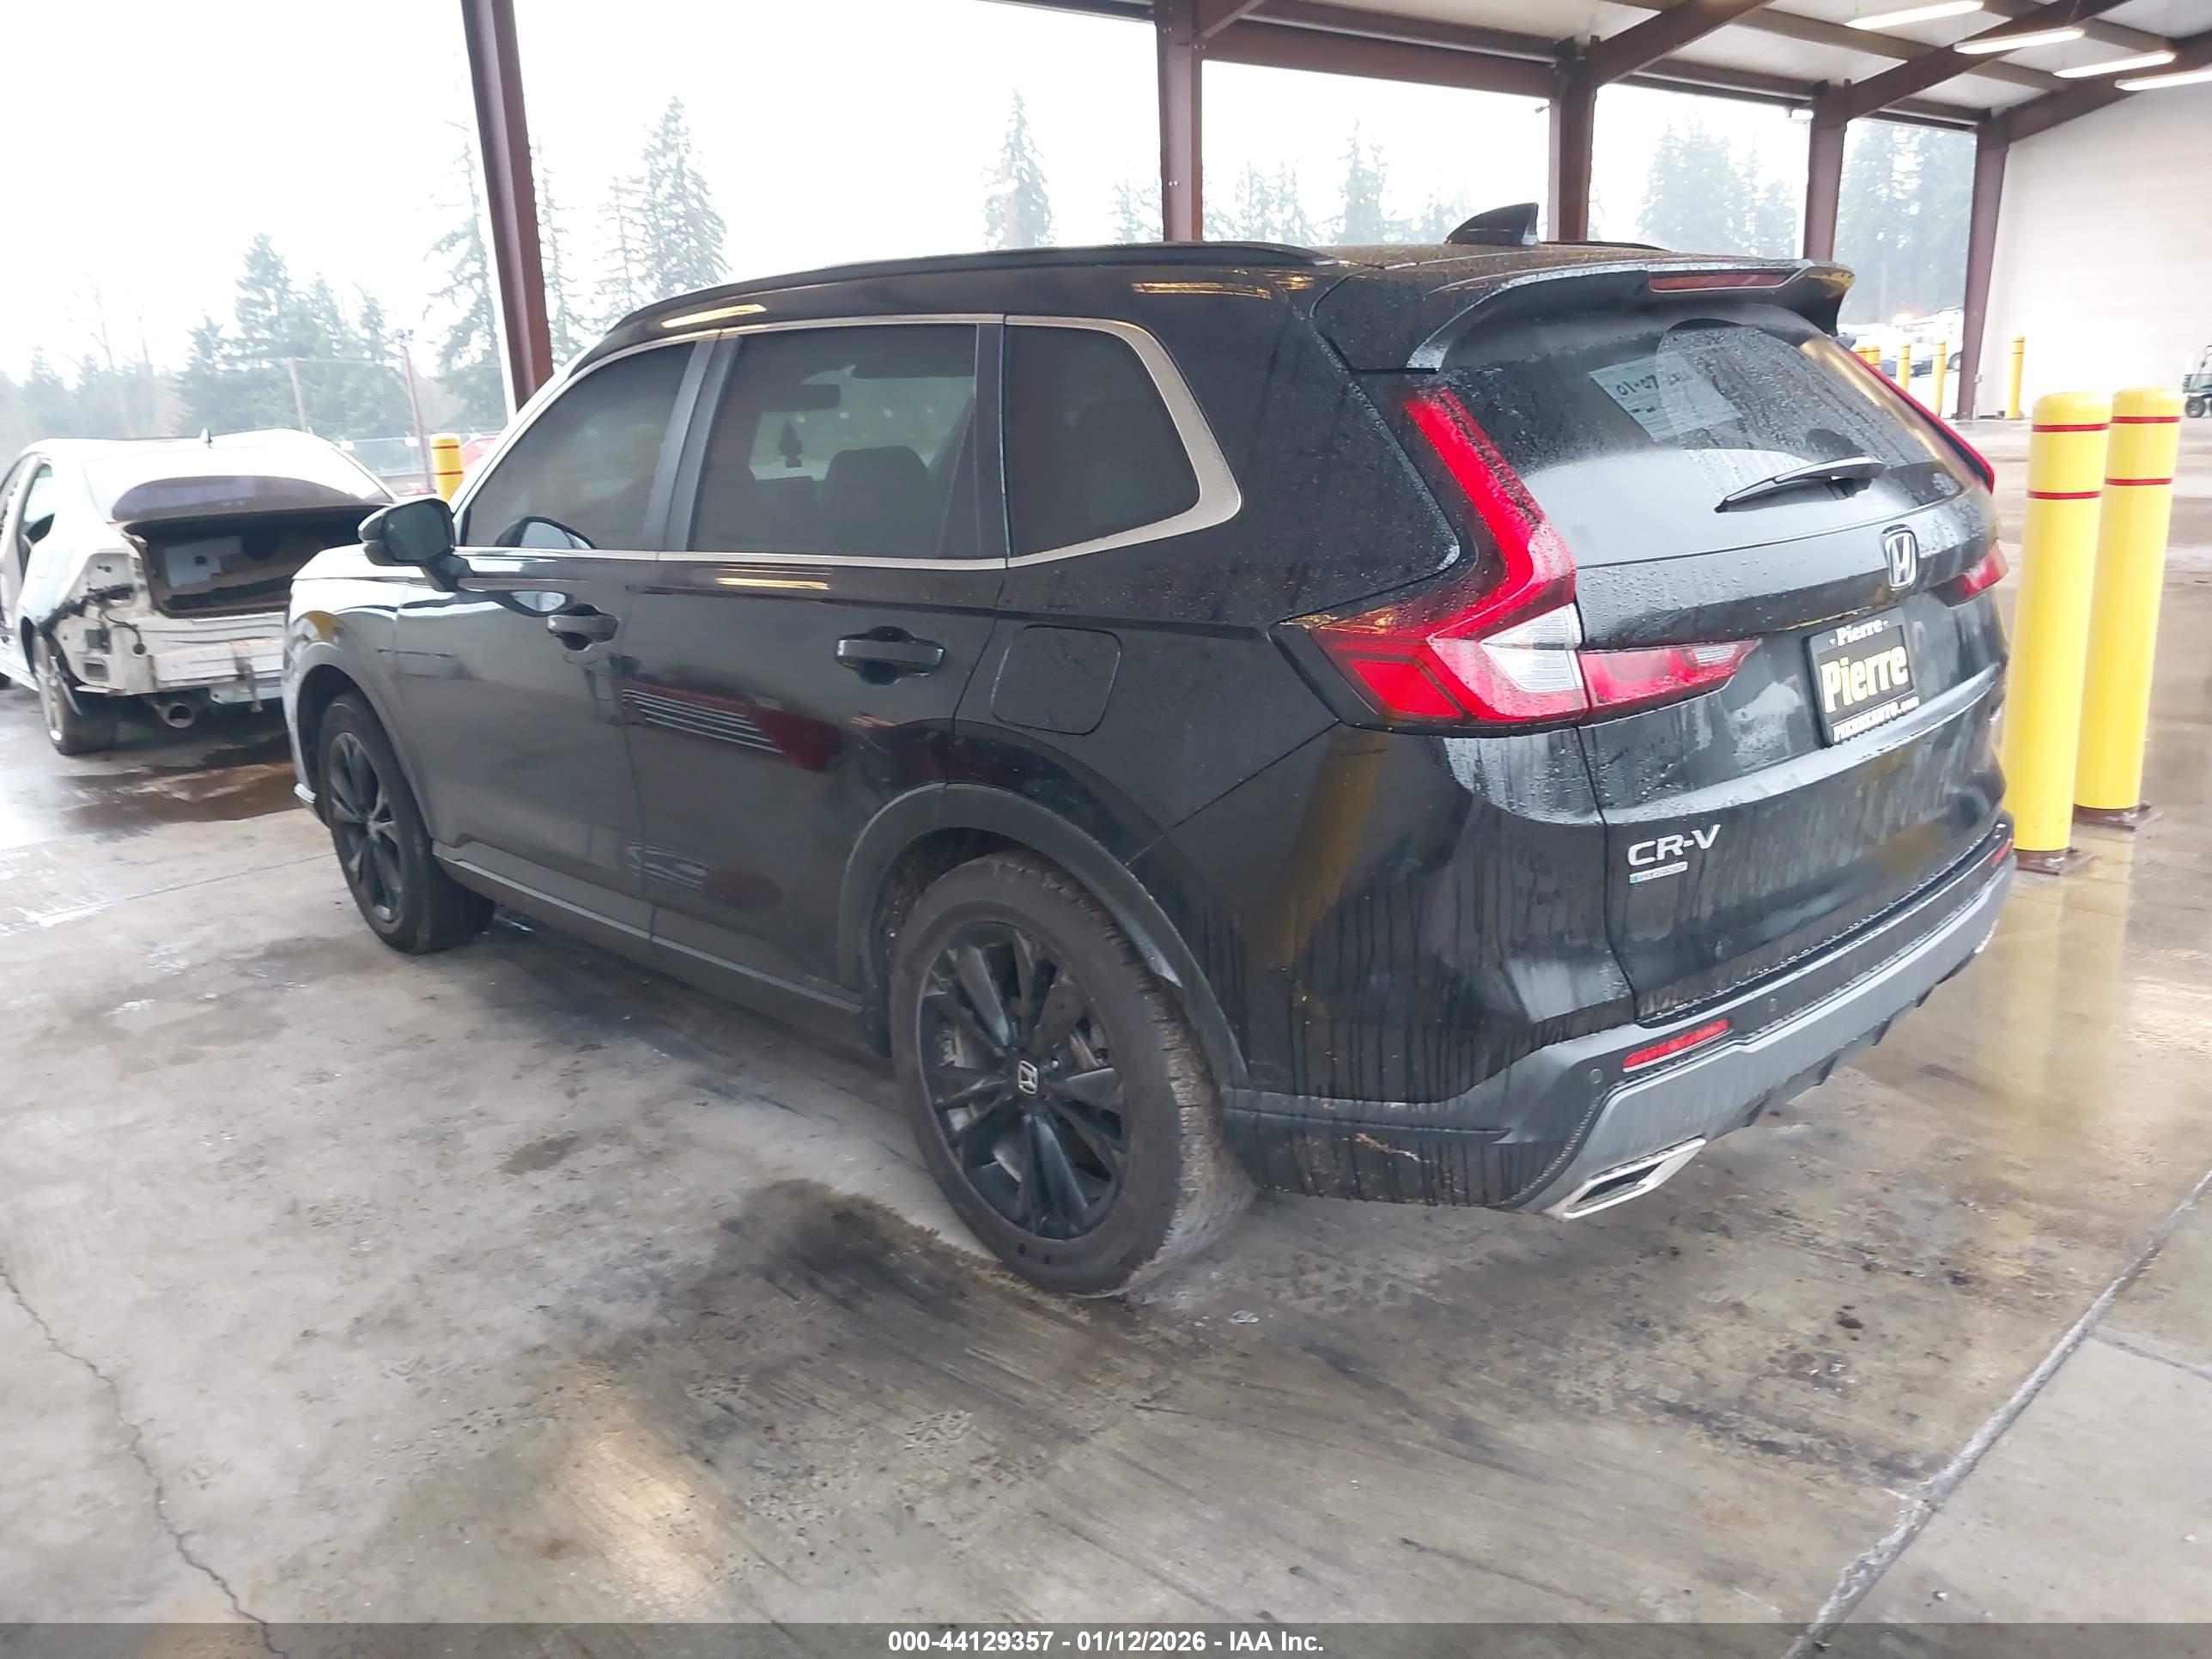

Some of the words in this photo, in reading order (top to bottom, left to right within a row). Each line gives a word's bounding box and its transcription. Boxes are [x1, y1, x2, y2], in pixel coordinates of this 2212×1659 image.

[1835, 618, 1883, 647] Pierre
[1820, 645, 1909, 714] Pierre
[1626, 823, 1722, 866] CR-V
